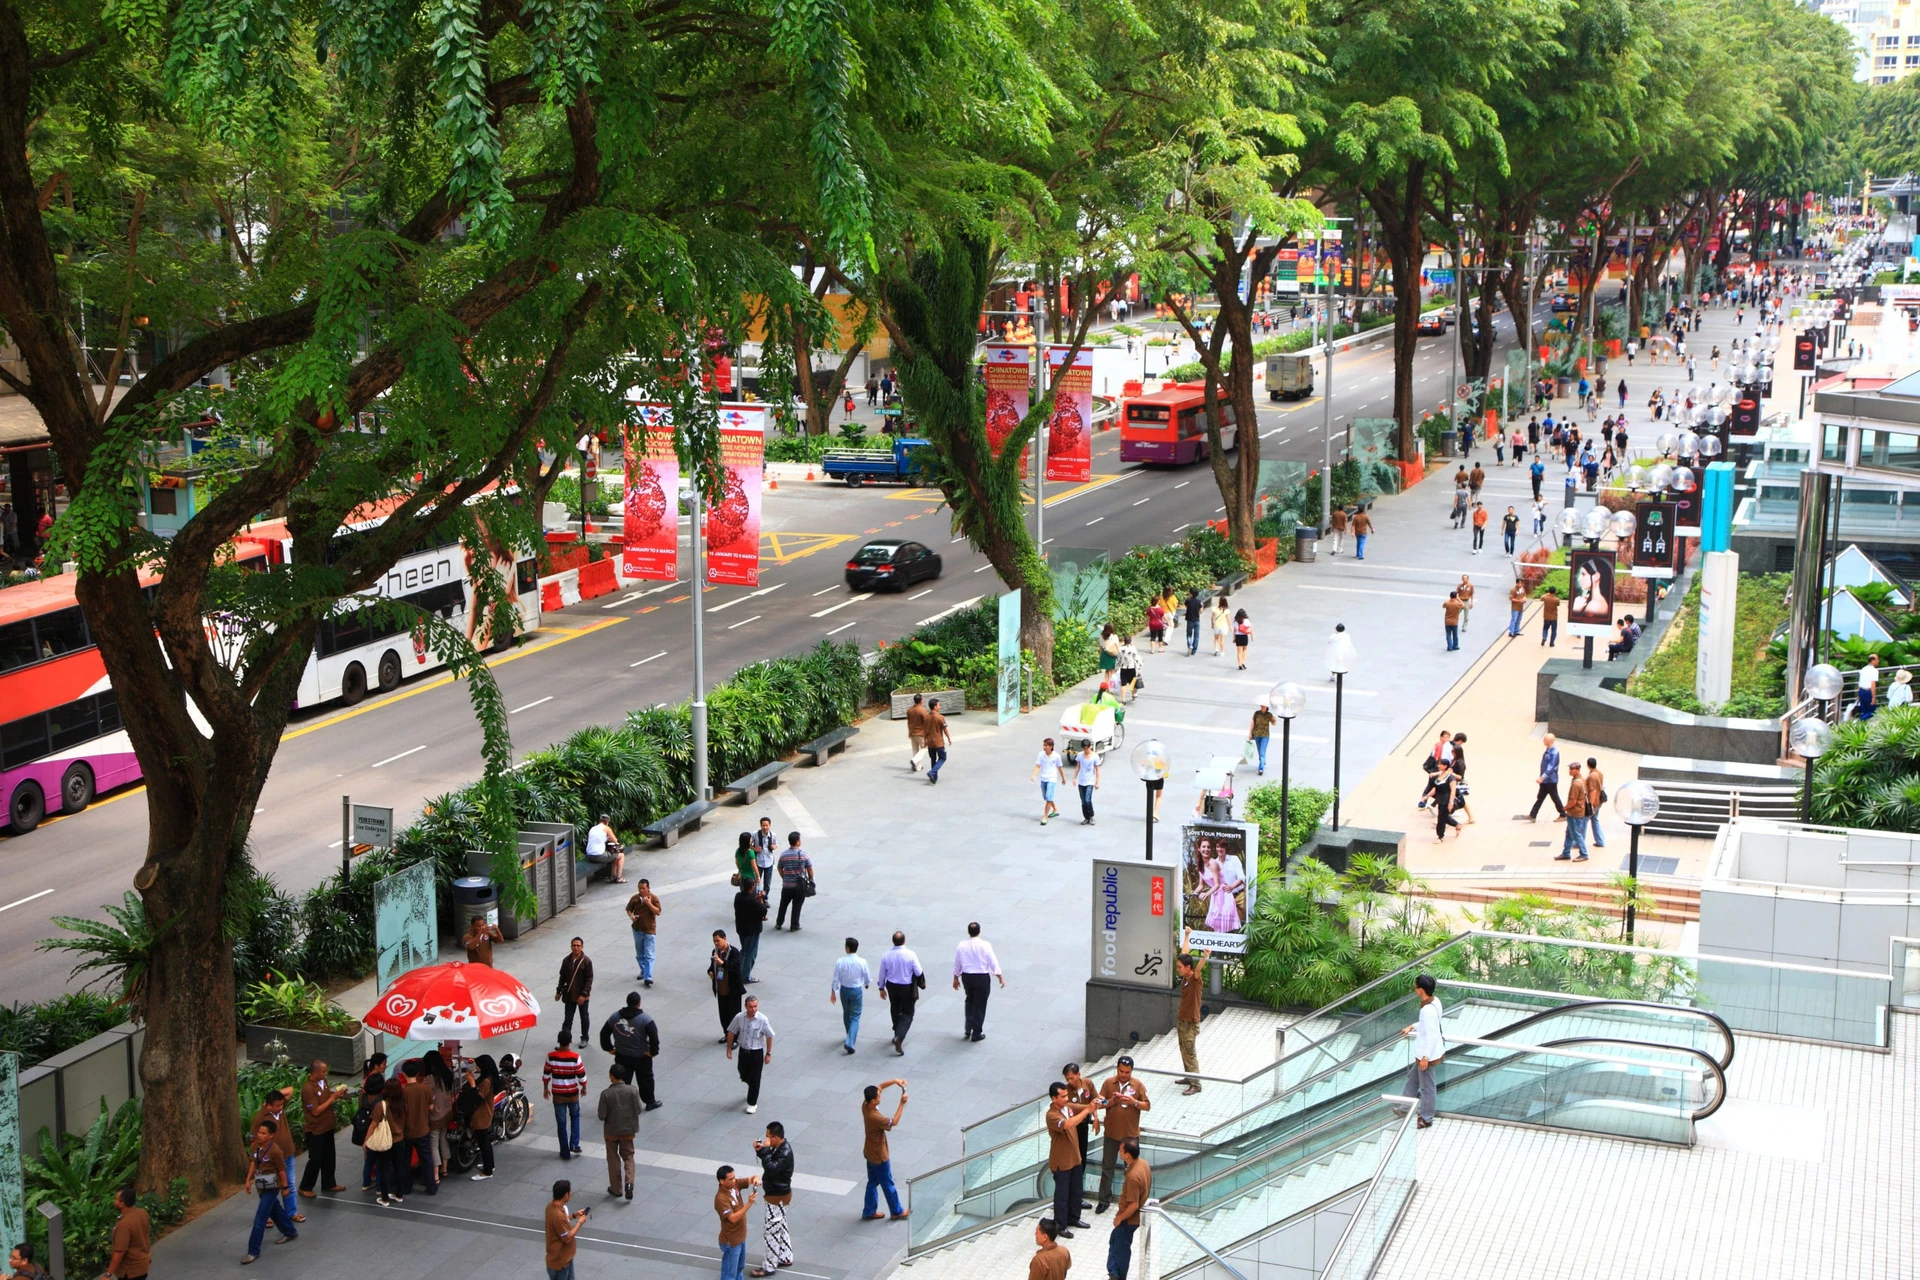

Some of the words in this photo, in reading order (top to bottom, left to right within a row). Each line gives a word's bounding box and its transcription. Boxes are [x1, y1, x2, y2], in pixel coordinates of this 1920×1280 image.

[988, 366, 1028, 374] CHINATOWN
[1051, 368, 1092, 376] CATOWN
[719, 434, 762, 445] INATOWN
[358, 816, 385, 825] PEDESTRIANS
[365, 825, 387, 833] Underpass
[1216, 831, 1242, 839] MOMENTS
[1189, 937, 1241, 949] GOLDHEART
[377, 1020, 400, 1035] WALL'S
[491, 1020, 521, 1034] WALL'S
